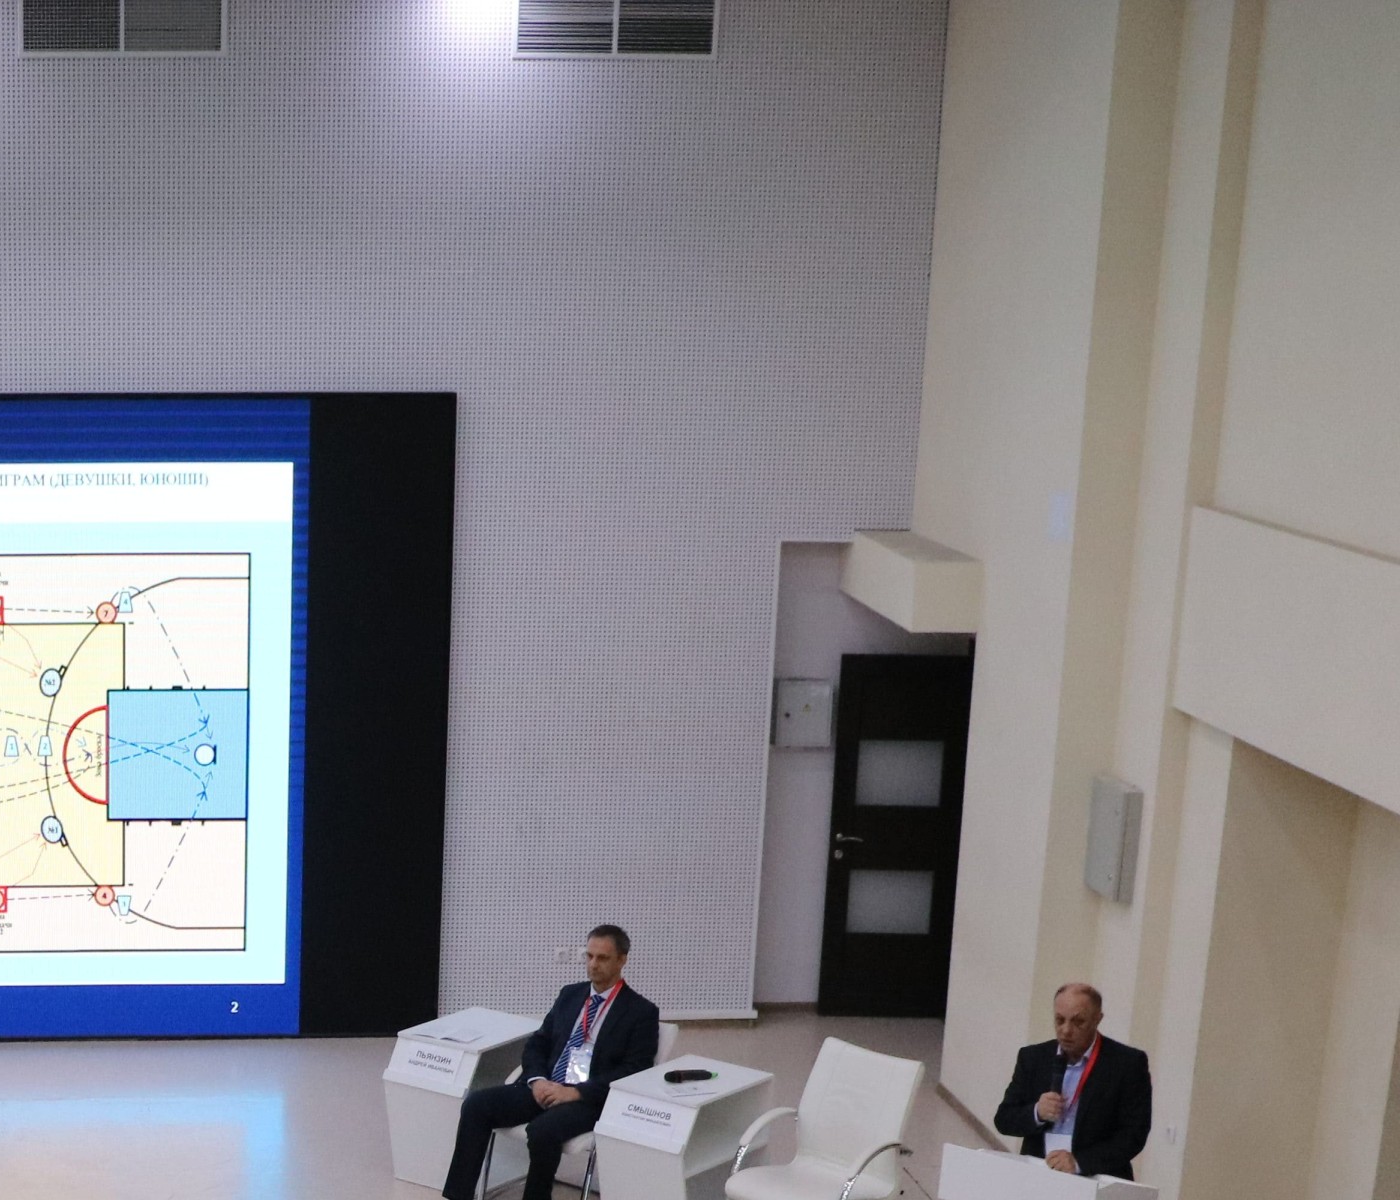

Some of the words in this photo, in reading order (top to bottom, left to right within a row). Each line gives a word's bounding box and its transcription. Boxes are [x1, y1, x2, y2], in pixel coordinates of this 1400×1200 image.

[50, 472, 136, 490] (ДЕВУШКИ,
[139, 472, 209, 488] ЮНОШИ)
[230, 1001, 239, 1014] 2
[416, 1050, 452, 1065] ПЬЯНЗИН
[627, 1103, 672, 1121] СМЫШНОВ
